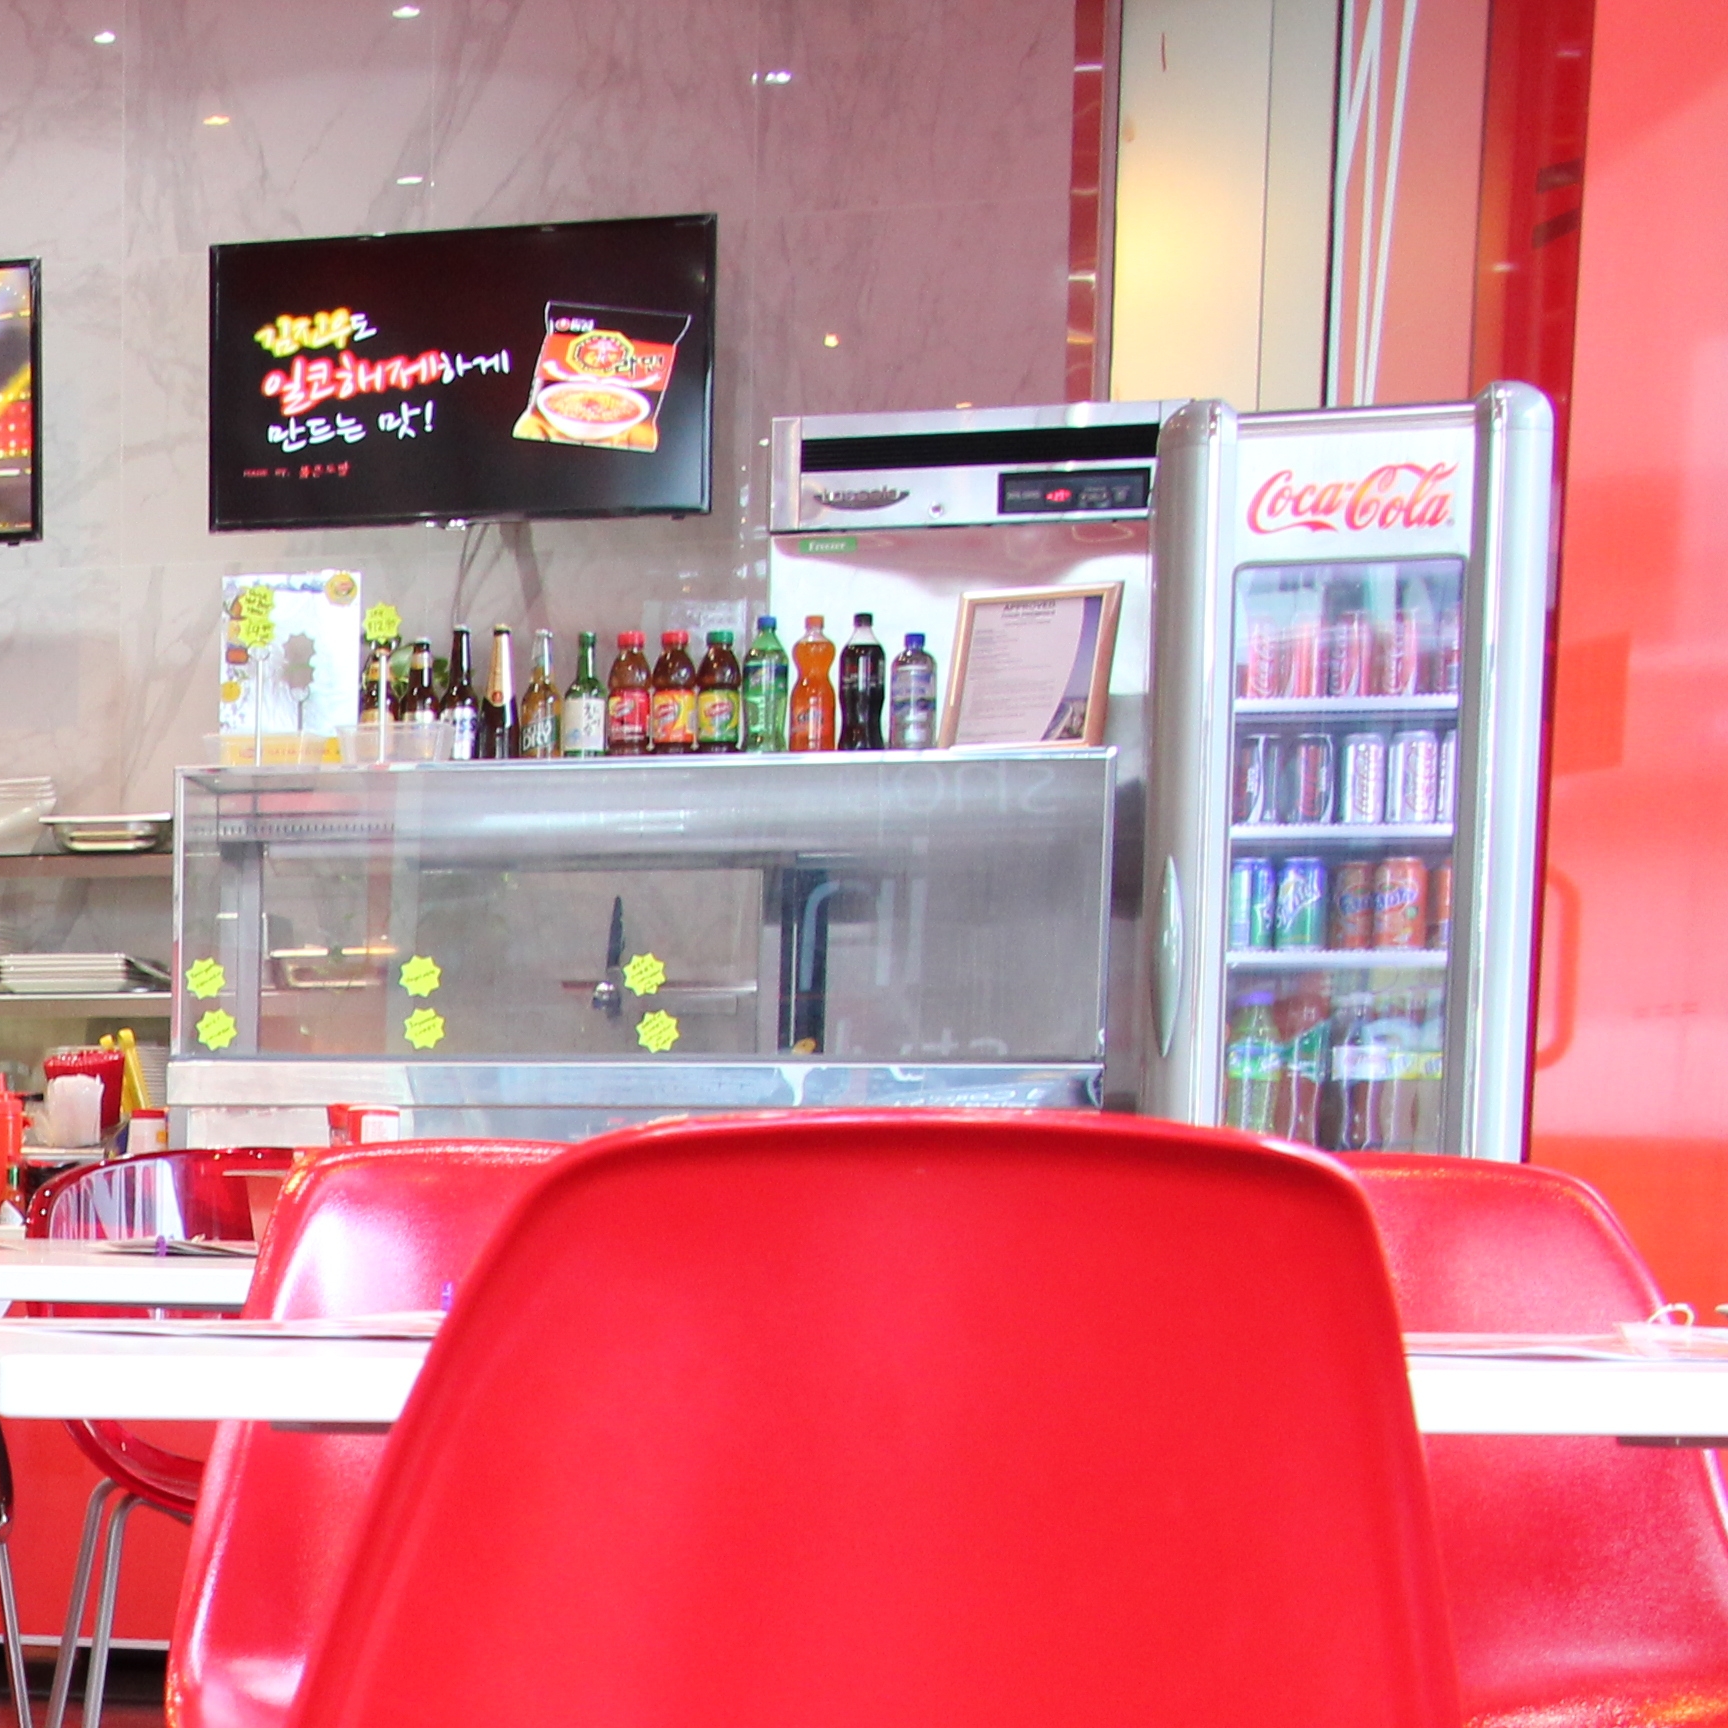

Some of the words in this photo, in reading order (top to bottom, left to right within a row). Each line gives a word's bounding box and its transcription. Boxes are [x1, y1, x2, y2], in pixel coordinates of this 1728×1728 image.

[267, 412, 366, 453] 만드는
[378, 400, 434, 440] 맛!
[1247, 461, 1458, 535] Coca-Cola
[809, 541, 846, 552] Freezer
